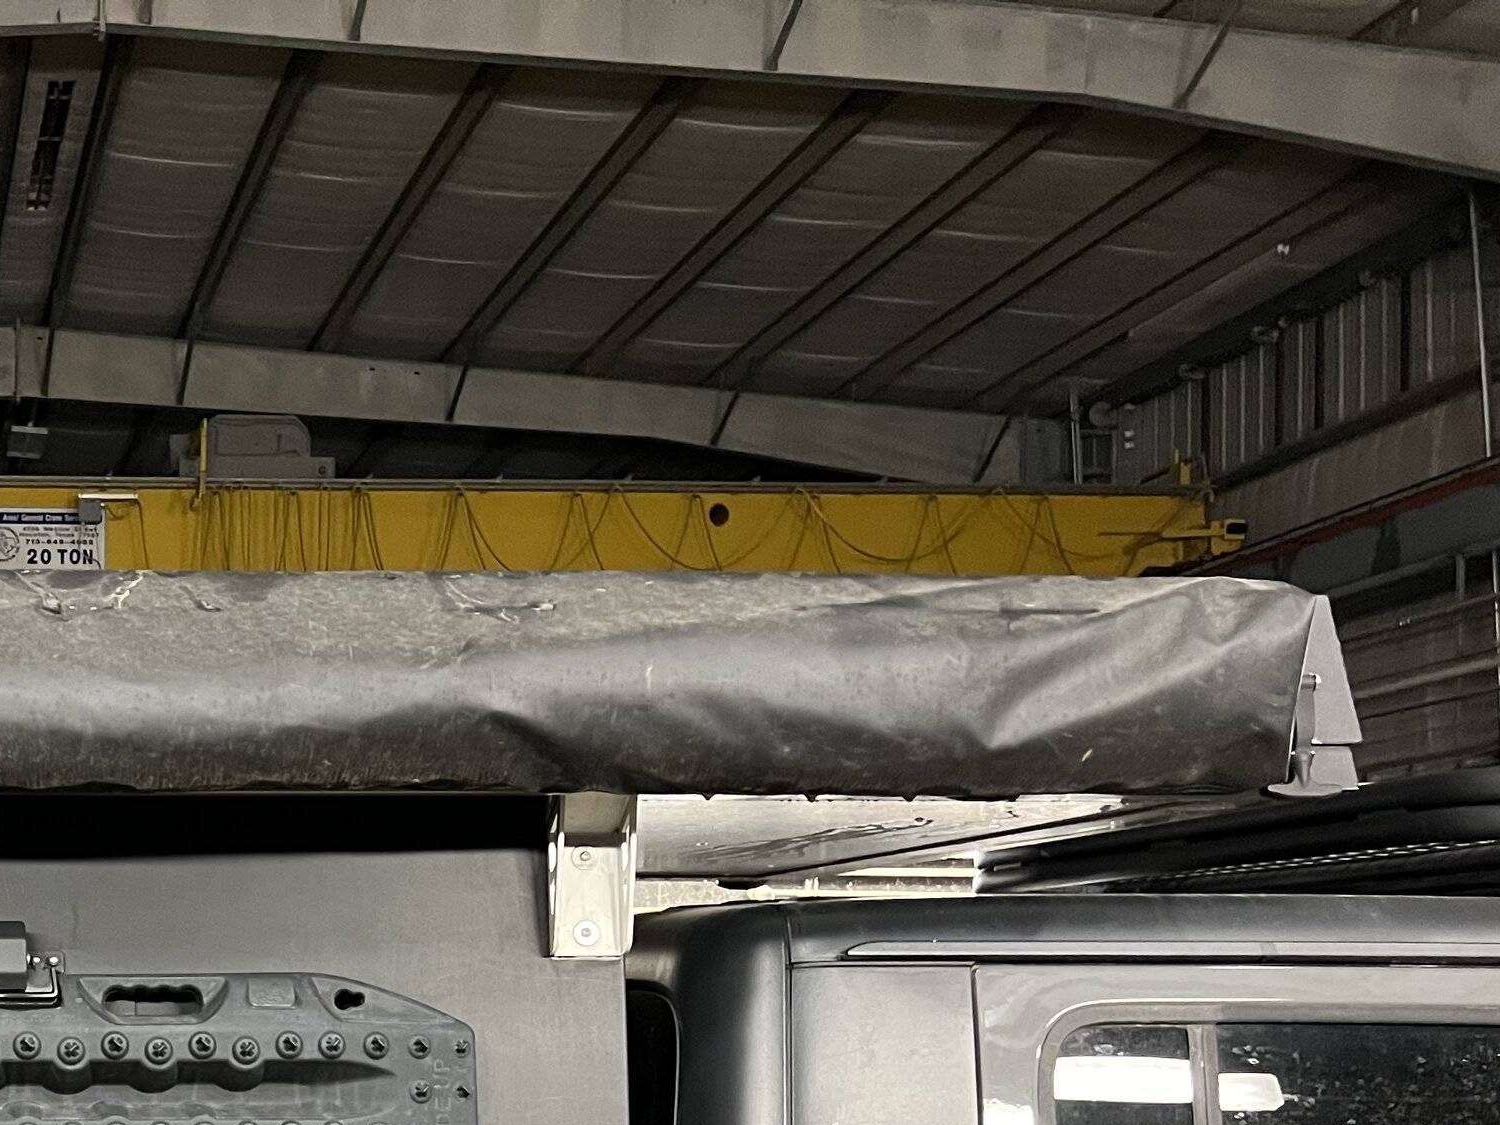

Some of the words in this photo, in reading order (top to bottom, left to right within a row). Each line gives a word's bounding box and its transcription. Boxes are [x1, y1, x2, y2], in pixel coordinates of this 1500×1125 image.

[26, 548, 52, 565] 20
[56, 548, 94, 565] TON
[432, 1058, 450, 1089] UP
